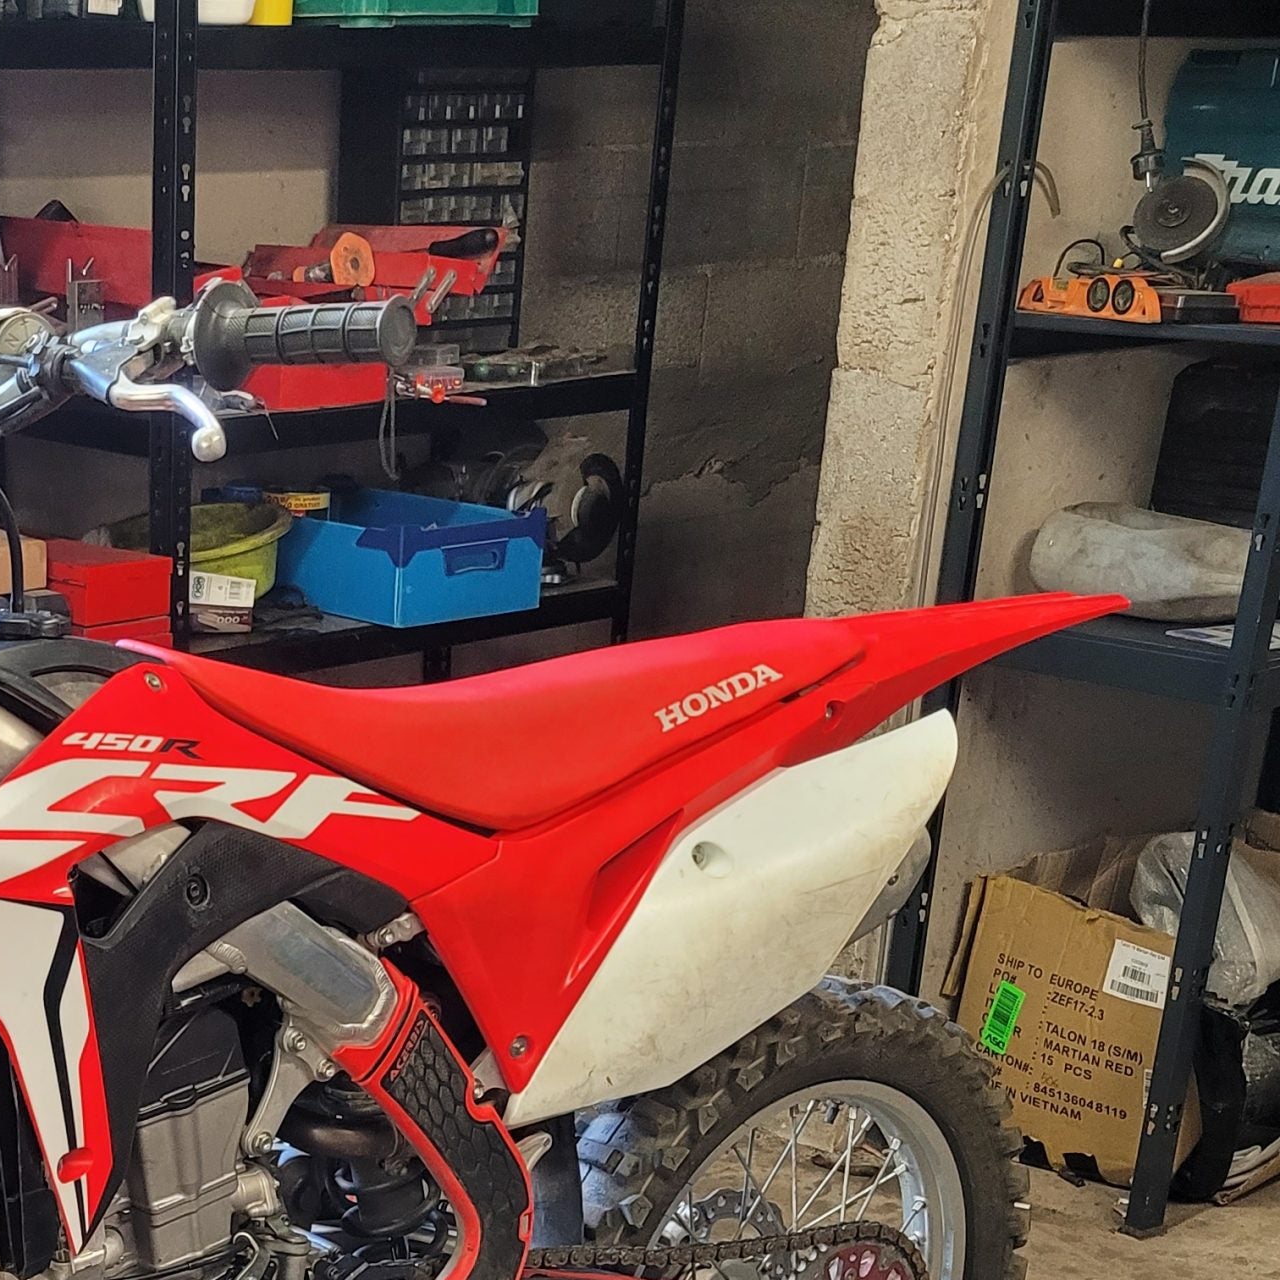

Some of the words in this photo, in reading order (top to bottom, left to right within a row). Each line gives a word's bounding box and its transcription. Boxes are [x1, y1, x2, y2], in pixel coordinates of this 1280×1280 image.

[654, 664, 783, 733] HONDA
[62, 732, 206, 761] 450R
[997, 953, 1025, 970] SHIP
[1028, 963, 1043, 979] TO
[1049, 974, 1099, 1000] EUROPE
[390, 1020, 424, 1082] ACERBIS
[1043, 1038, 1101, 1067] MARTIAN
[1104, 1059, 1134, 1077] RED
[1045, 1021, 1087, 1046] TALON
[1091, 1039, 1106, 1051] 18
[1107, 1044, 1143, 1065] (S/M)
[1040, 1053, 1054, 1066] 15
[1063, 1063, 1093, 1080] PCS
[1020, 1091, 1082, 1121] VIETNAM
[1033, 1082, 1128, 1120] 845136048119
